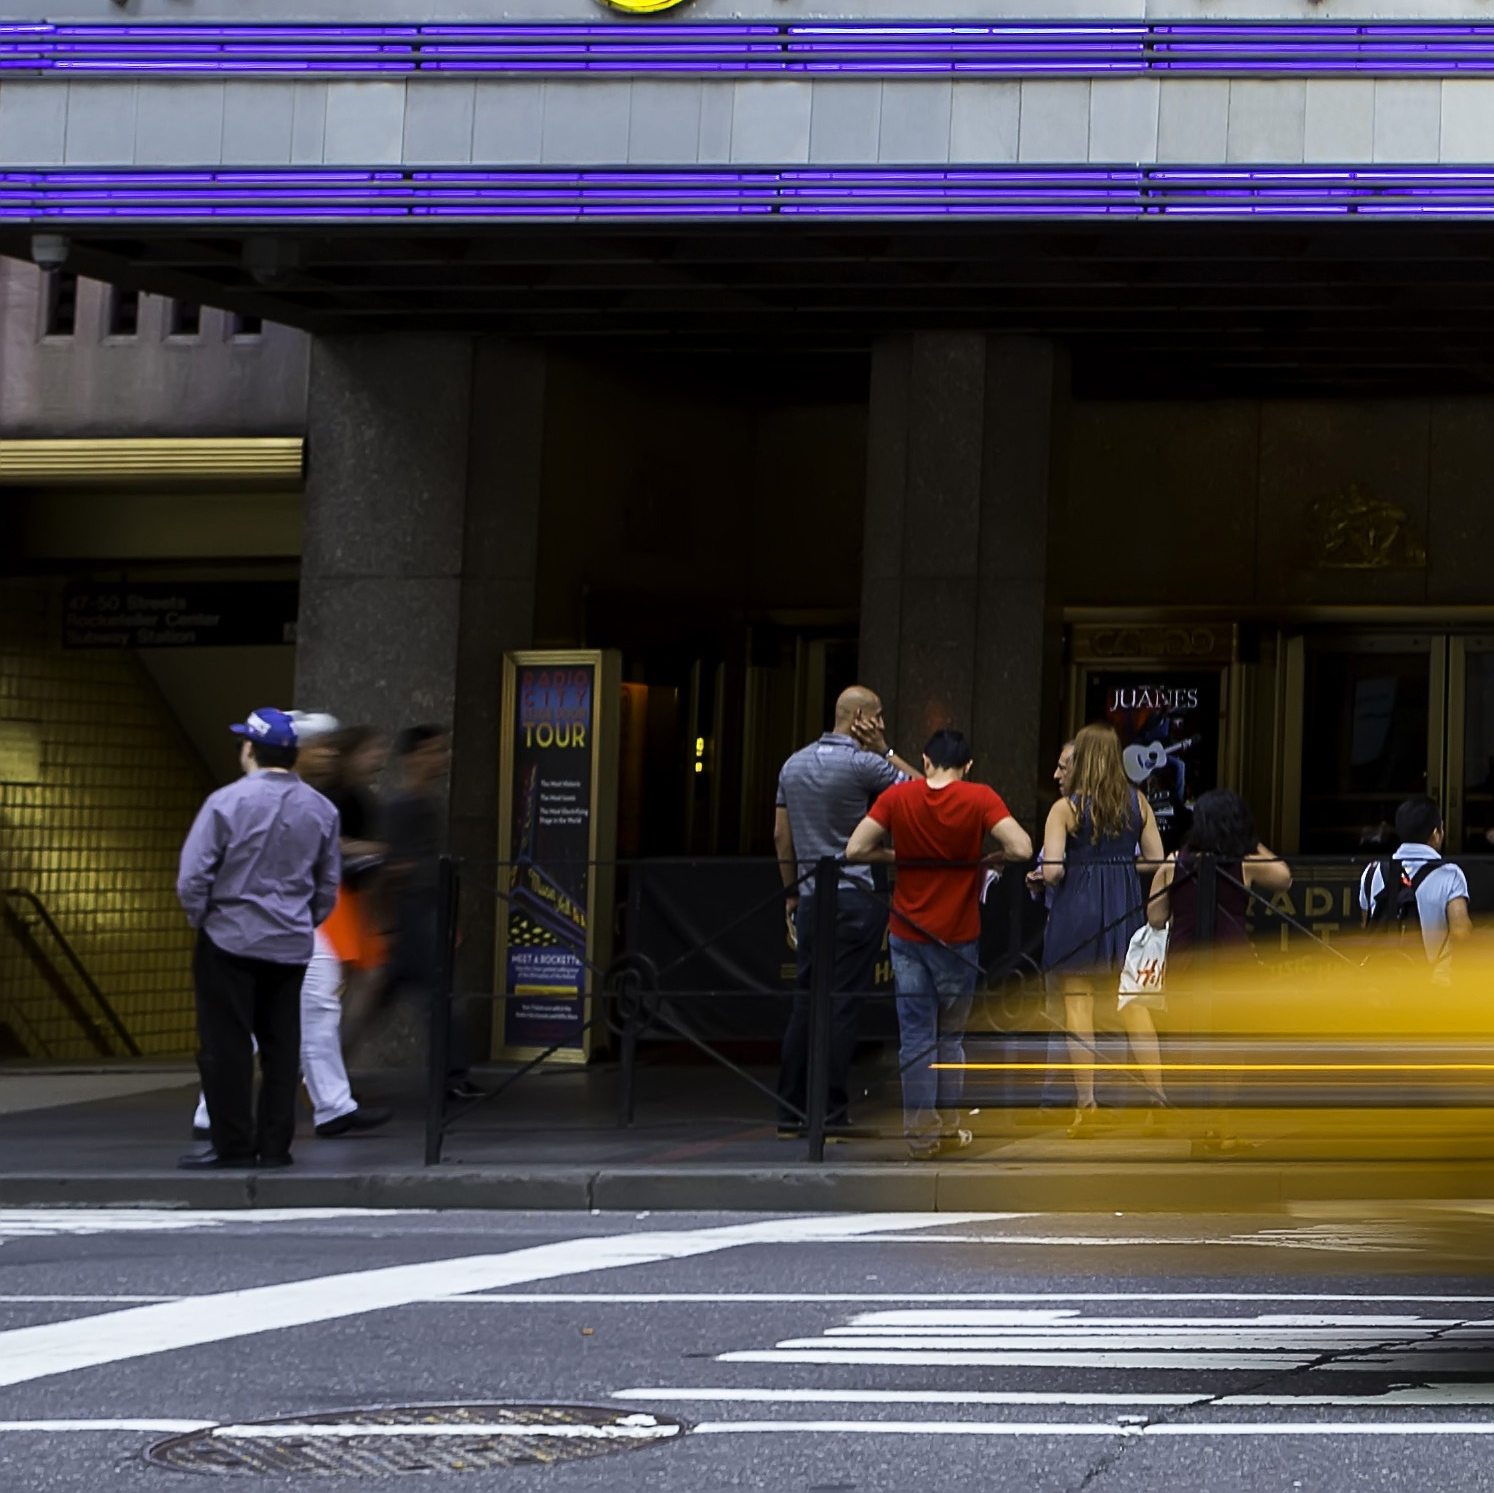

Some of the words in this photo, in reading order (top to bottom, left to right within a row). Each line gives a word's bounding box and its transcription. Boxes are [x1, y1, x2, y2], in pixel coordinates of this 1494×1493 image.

[523, 670, 590, 688] RADIO
[523, 689, 586, 707] CITY
[1109, 687, 1199, 712] JUANES
[523, 723, 586, 748] TOUR
